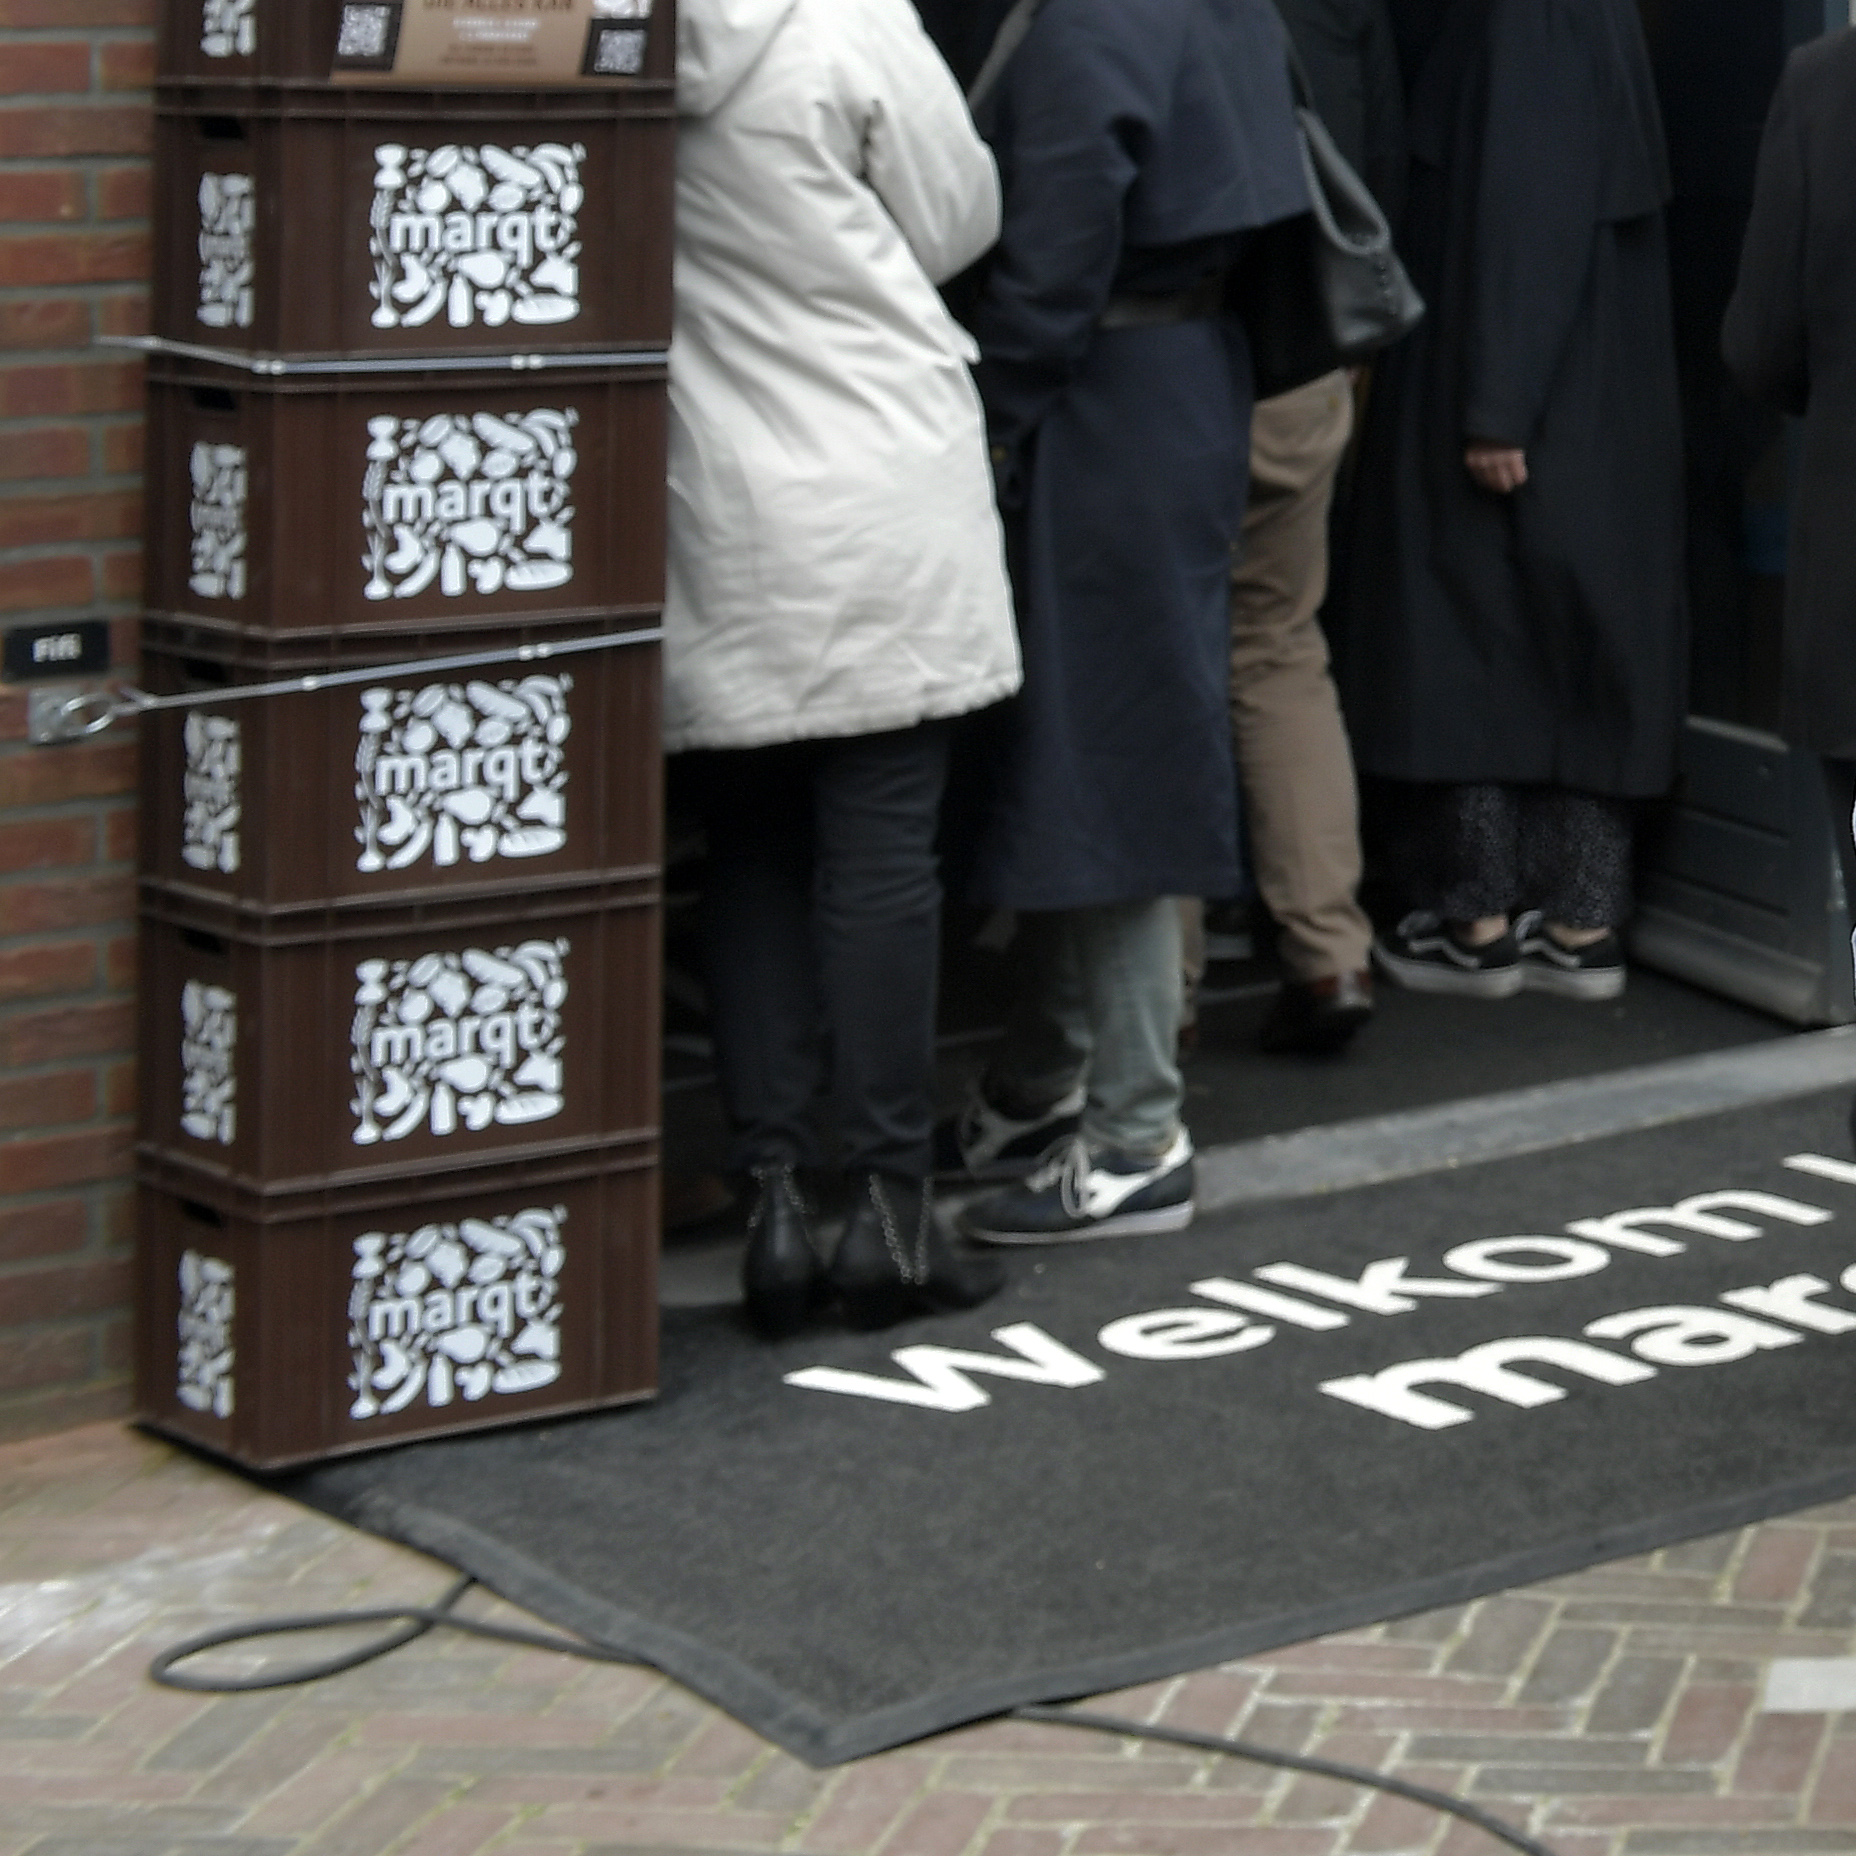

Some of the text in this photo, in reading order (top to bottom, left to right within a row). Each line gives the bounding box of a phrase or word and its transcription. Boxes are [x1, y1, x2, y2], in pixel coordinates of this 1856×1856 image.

[390, 204, 559, 269] marqt
[383, 471, 552, 534] marqt
[376, 738, 546, 802] marqt
[372, 1003, 541, 1070] marqt
[370, 1272, 539, 1339] marqt
[784, 1187, 1834, 1414] Welkom
